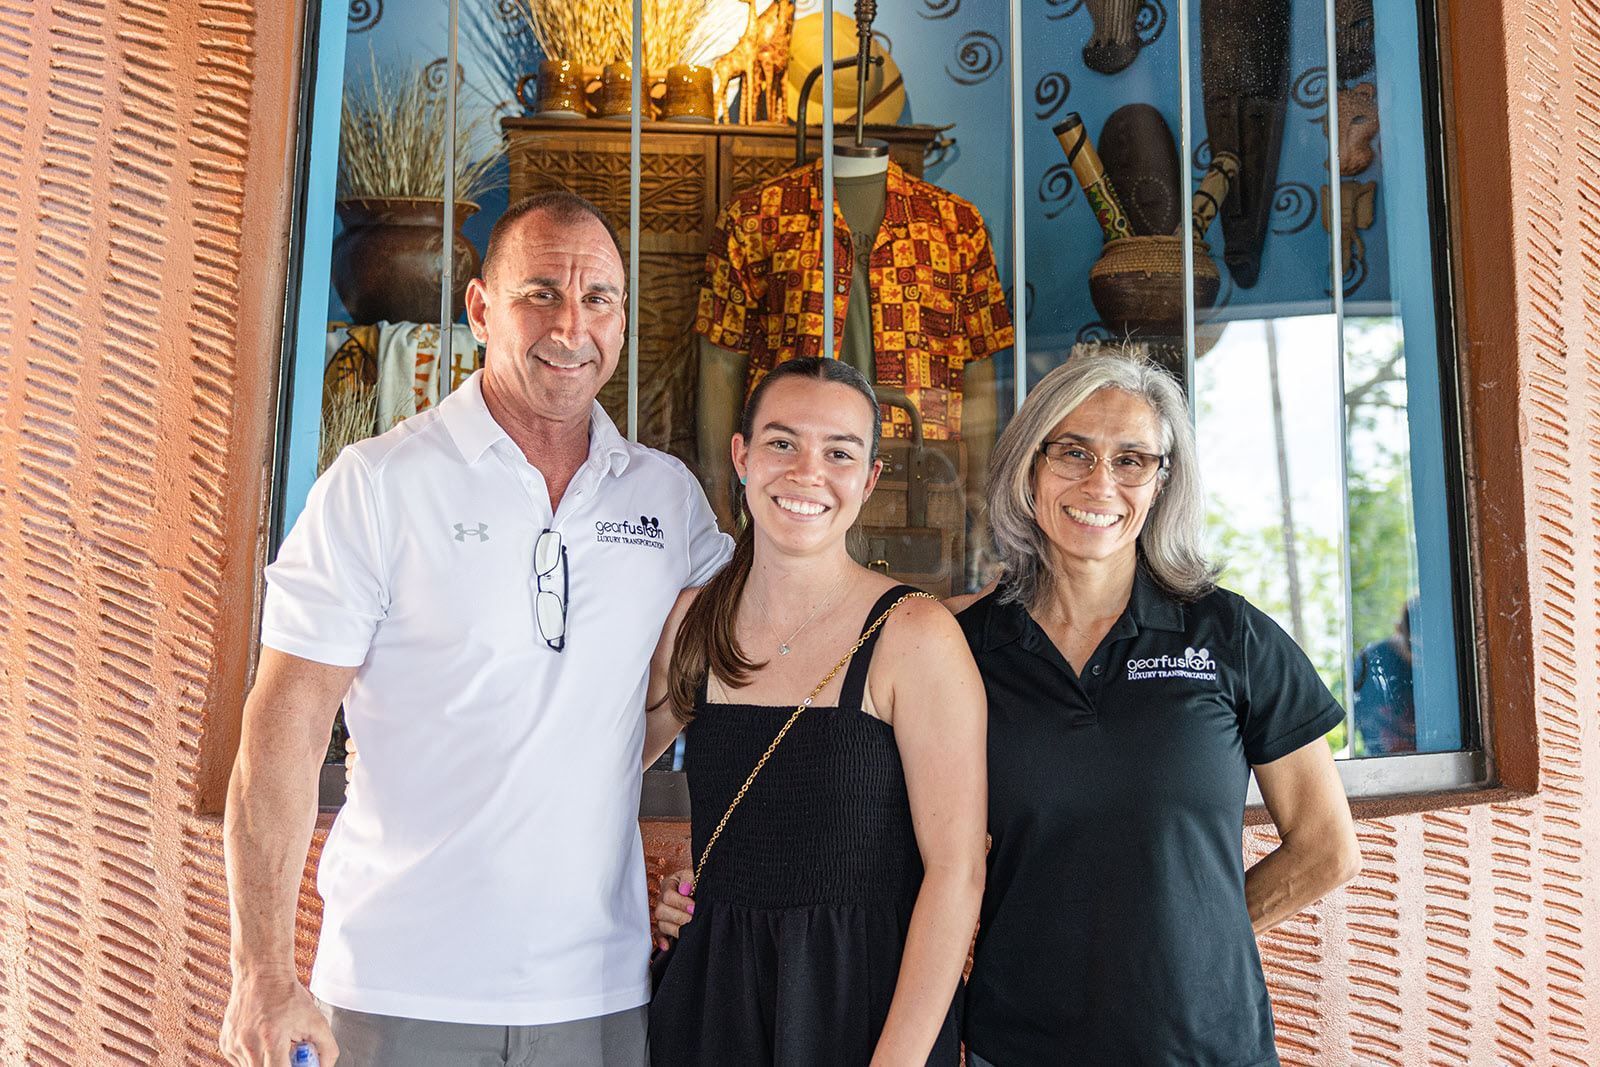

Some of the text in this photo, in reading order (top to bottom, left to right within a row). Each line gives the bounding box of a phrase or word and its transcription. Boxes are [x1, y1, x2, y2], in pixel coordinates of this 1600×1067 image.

[595, 515, 664, 539] gearfusion
[597, 535, 664, 549] LUXURY TRANSPORTATION
[1127, 647, 1216, 673] gearfusion
[1128, 670, 1216, 680] LUXURY TRANSPORTATION
